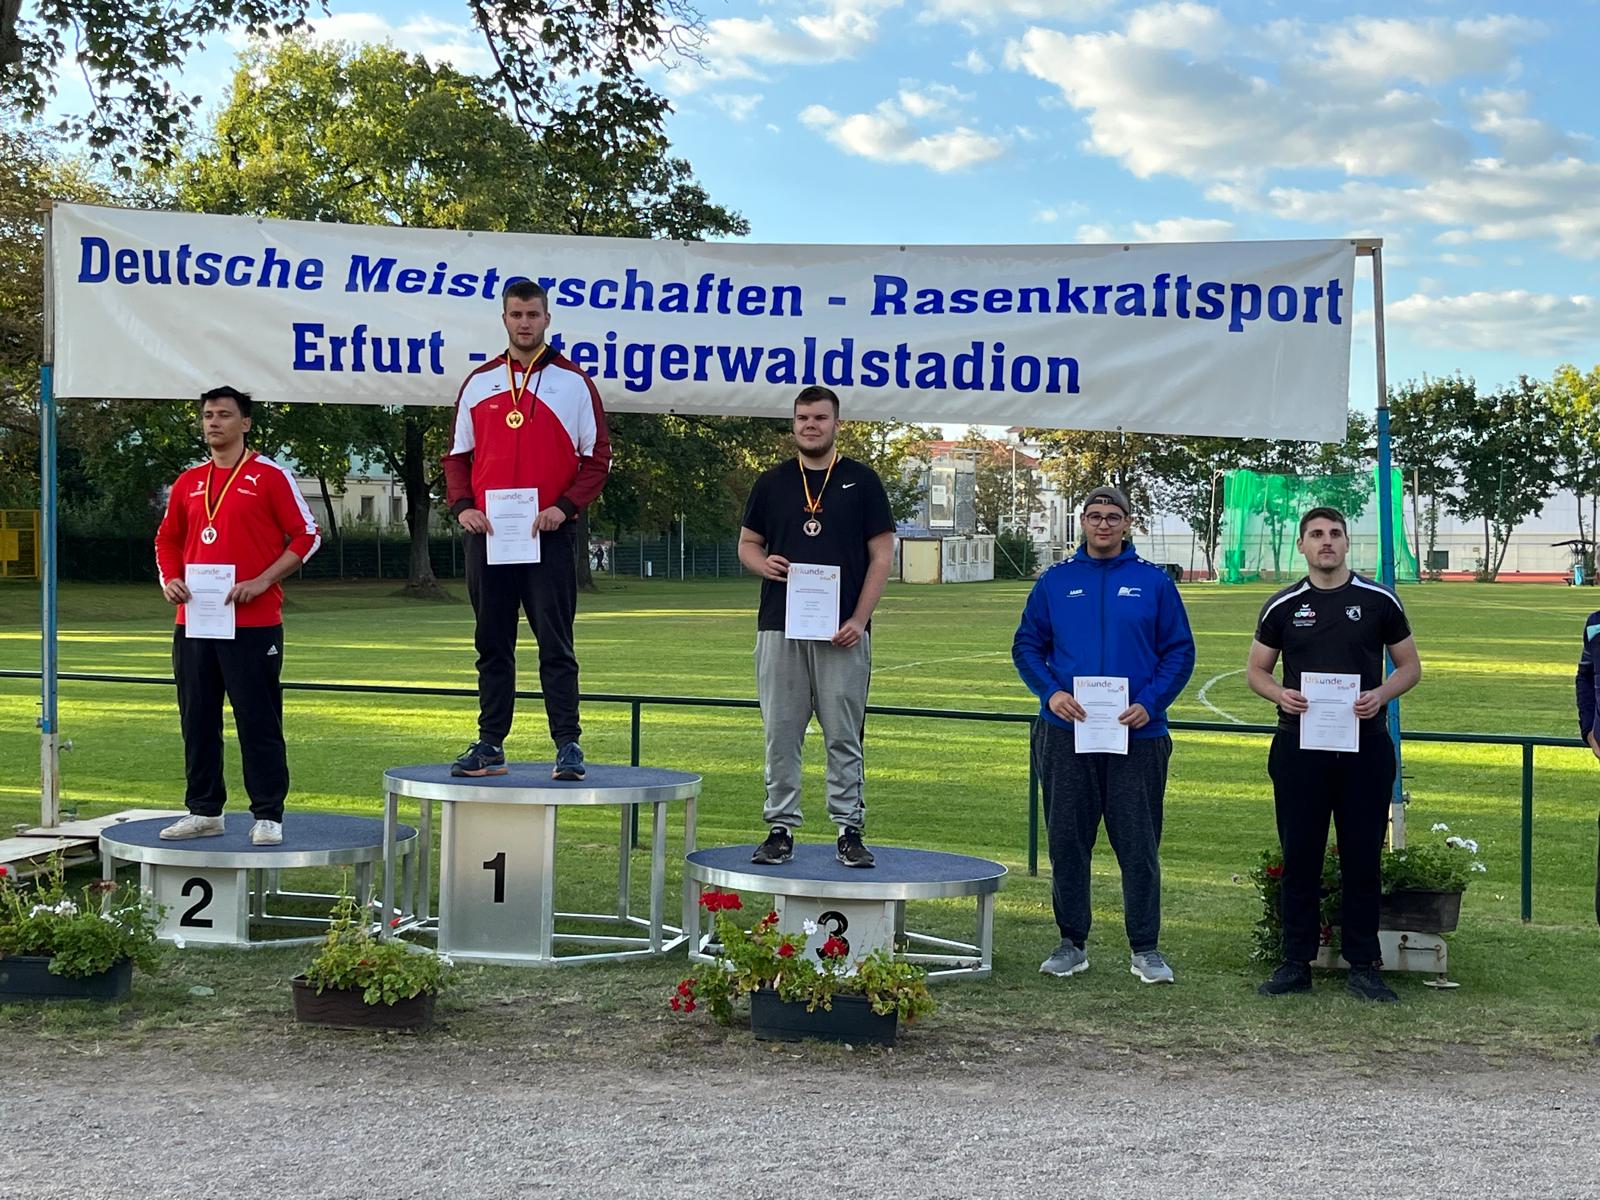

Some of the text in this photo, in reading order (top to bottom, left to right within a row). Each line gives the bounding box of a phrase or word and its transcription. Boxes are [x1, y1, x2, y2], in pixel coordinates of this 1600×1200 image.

[78, 236, 324, 291] Deutsche
[870, 274, 1344, 333] Rasenkraftsport
[292, 322, 445, 375] Erfurt
[180, 877, 213, 928] 2
[482, 852, 506, 903] 1
[815, 910, 850, 963] 3
